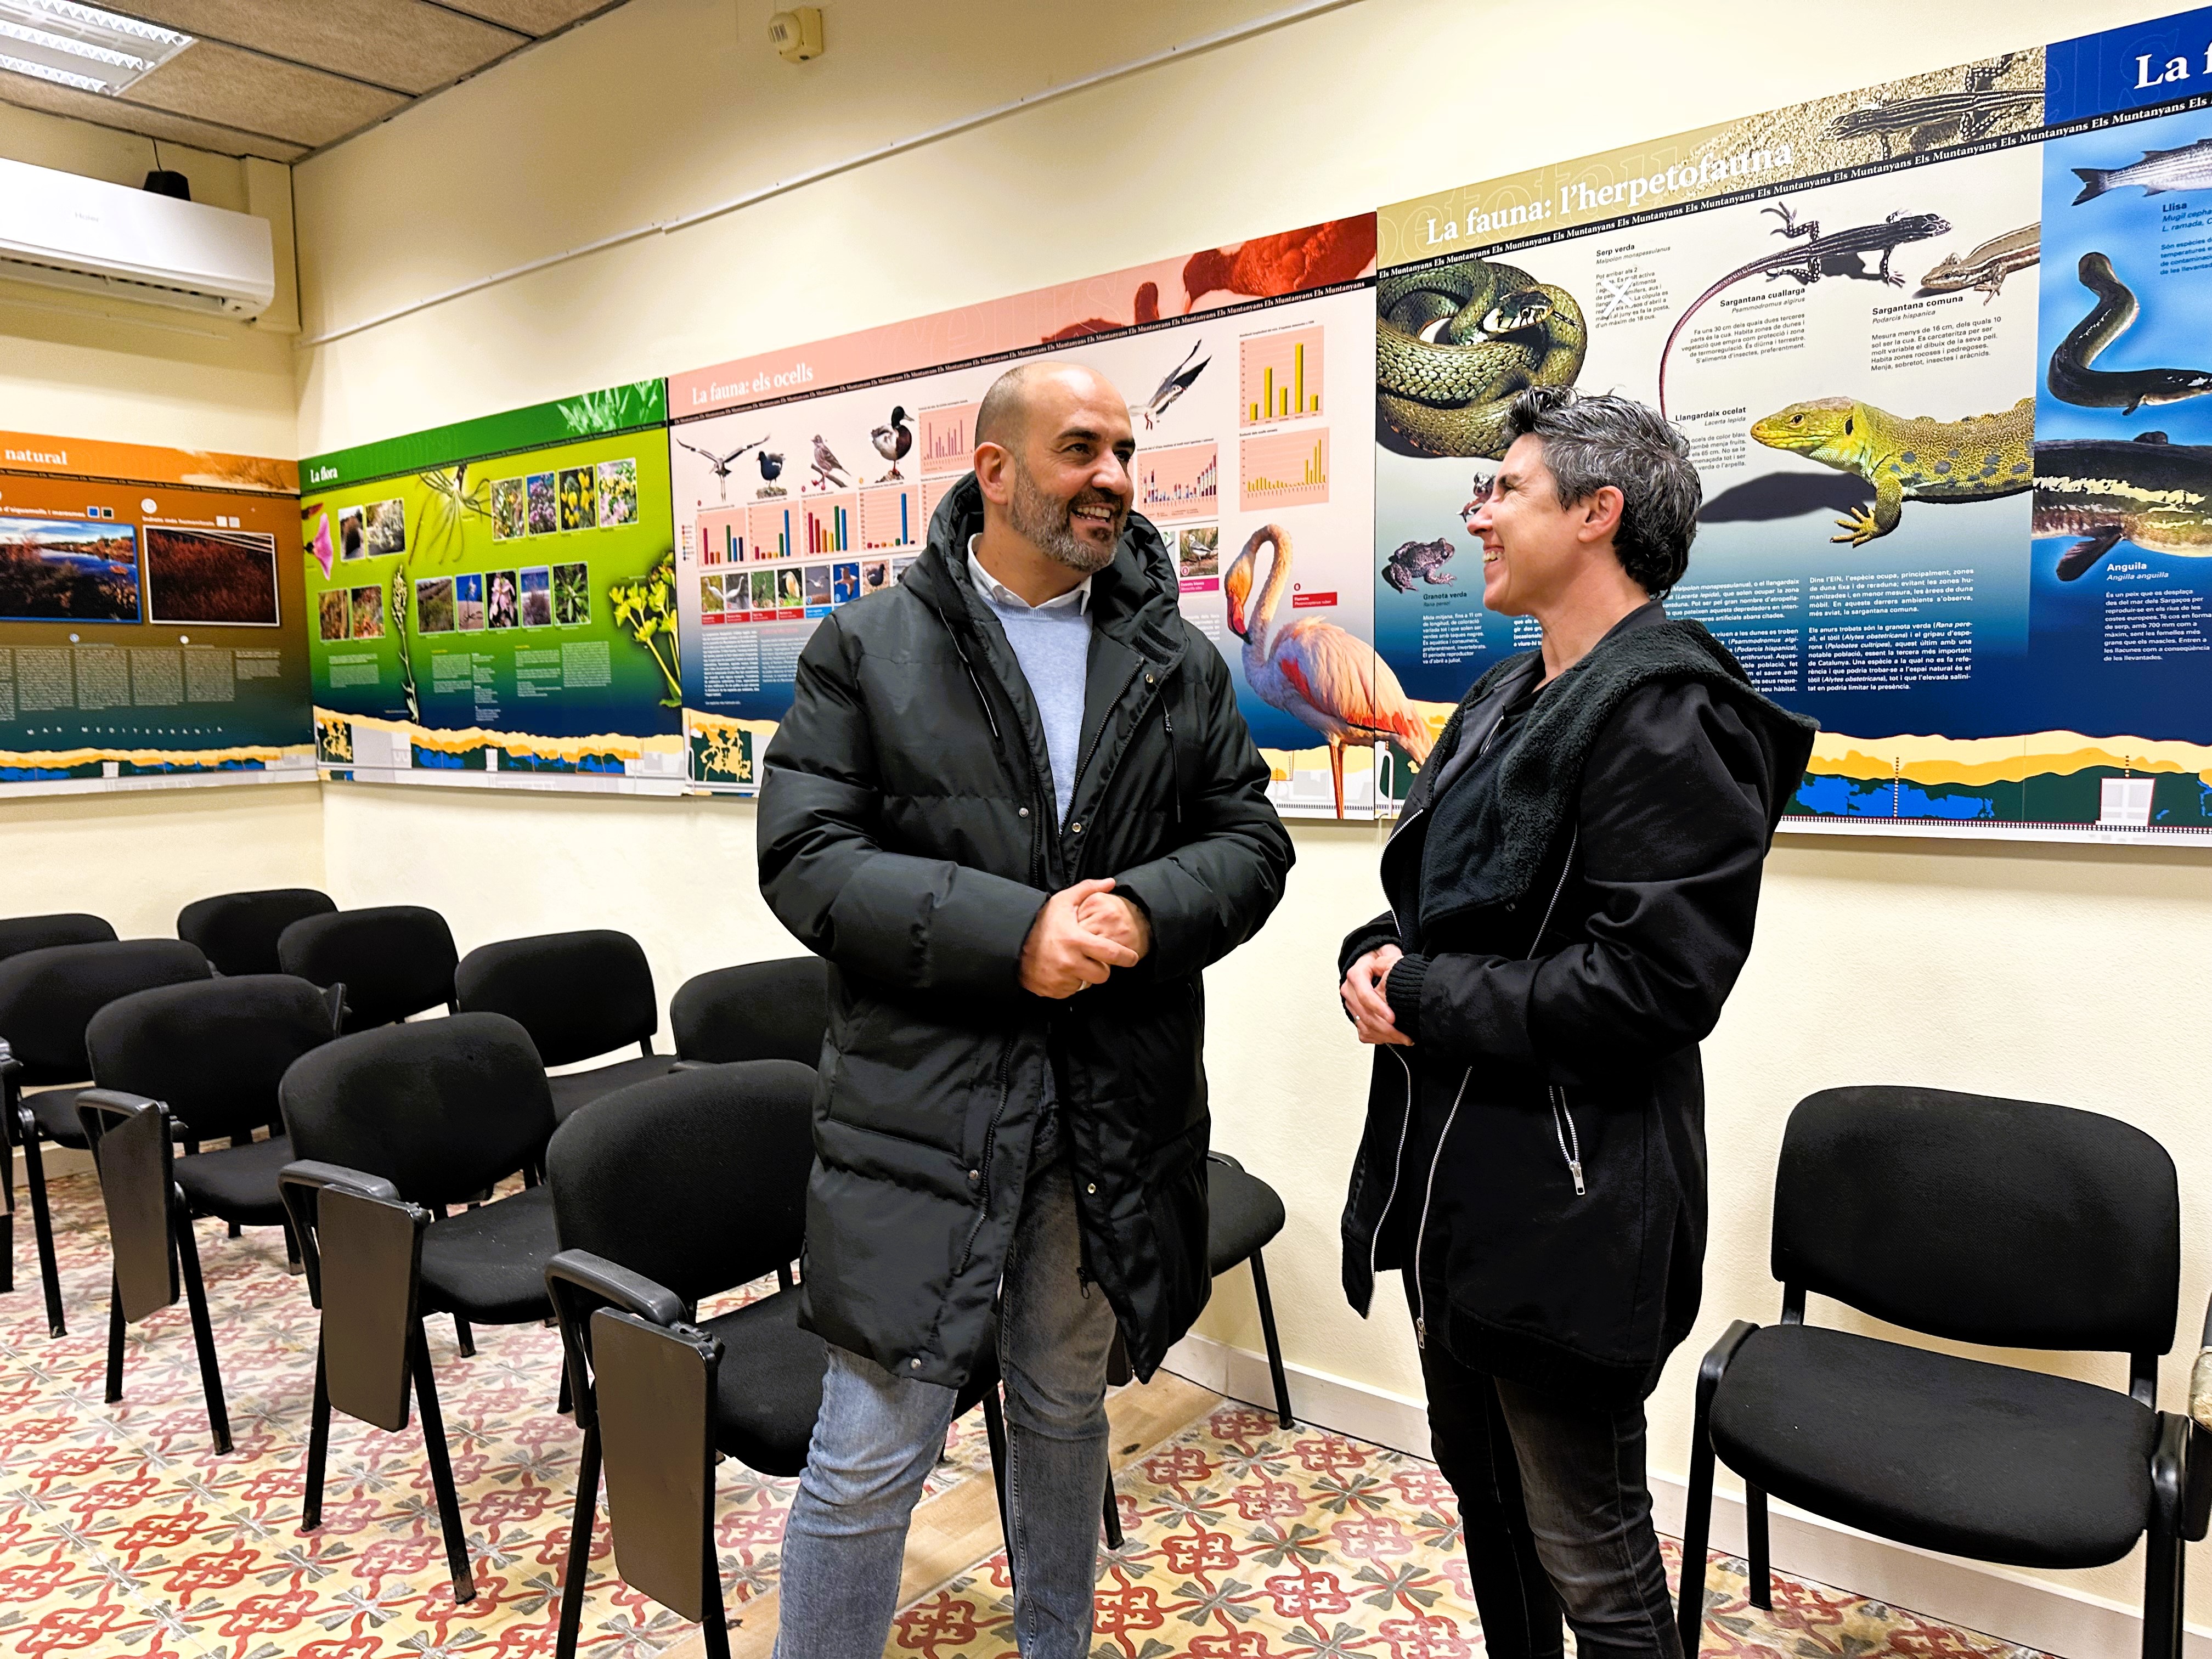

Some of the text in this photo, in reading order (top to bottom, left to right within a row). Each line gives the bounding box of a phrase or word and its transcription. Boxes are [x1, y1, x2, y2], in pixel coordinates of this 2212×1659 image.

[2134, 54, 2190, 89] La
[1391, 262, 1432, 275] Muntanyans
[1446, 249, 1489, 263] Muntanyans
[1505, 236, 1550, 251] Muntanyans
[1553, 232, 1564, 240] Els
[1567, 222, 1615, 238] Muntanyans
[1618, 218, 1629, 227] Els
[1632, 208, 1683, 223] Muntanyans
[1685, 203, 1698, 212] Els
[1701, 193, 1754, 209] Muntanyans
[1758, 188, 1770, 198] Els
[1774, 177, 1830, 194] Muntanyans
[1834, 172, 1847, 181] Els
[1851, 160, 1911, 178] Muntanyans
[1915, 155, 1929, 165] Els
[1933, 142, 1997, 161] Muntanyans
[2001, 137, 2016, 147] Els
[2020, 123, 2088, 143] Muntanyans
[2092, 117, 2108, 128] Els
[2112, 103, 2185, 123] Muntanyans
[2189, 98, 2207, 108] Els
[2163, 203, 2187, 212] Llisa
[2187, 208, 2212, 218] cepha
[1426, 218, 1458, 245] La
[1466, 199, 1551, 236] fauna:
[1596, 246, 1670, 264] Malpolon monspessulanus
[1615, 244, 1634, 253] verda
[1720, 288, 1804, 307] Sargantana cuallarga
[1138, 321, 1172, 332] Muntanyans
[1182, 312, 1217, 323] Muntanyans
[1227, 302, 1263, 314] Muntanyans
[1275, 292, 1312, 304] Muntanyans
[1325, 281, 1364, 294] Muntanyans
[1731, 301, 1781, 313] Psammodromus
[1872, 296, 1962, 315] Sargantana comuna
[1872, 311, 1936, 324] Podarcis hispanica
[1972, 318, 1991, 327] quals
[692, 363, 813, 405] La fauna: els ocells
[1675, 407, 1746, 421] Llangardaix ocelat
[5, 449, 67, 465] natural
[311, 469, 320, 483] La
[2107, 562, 2147, 572] Anguila
[2136, 572, 2169, 580] anguilla
